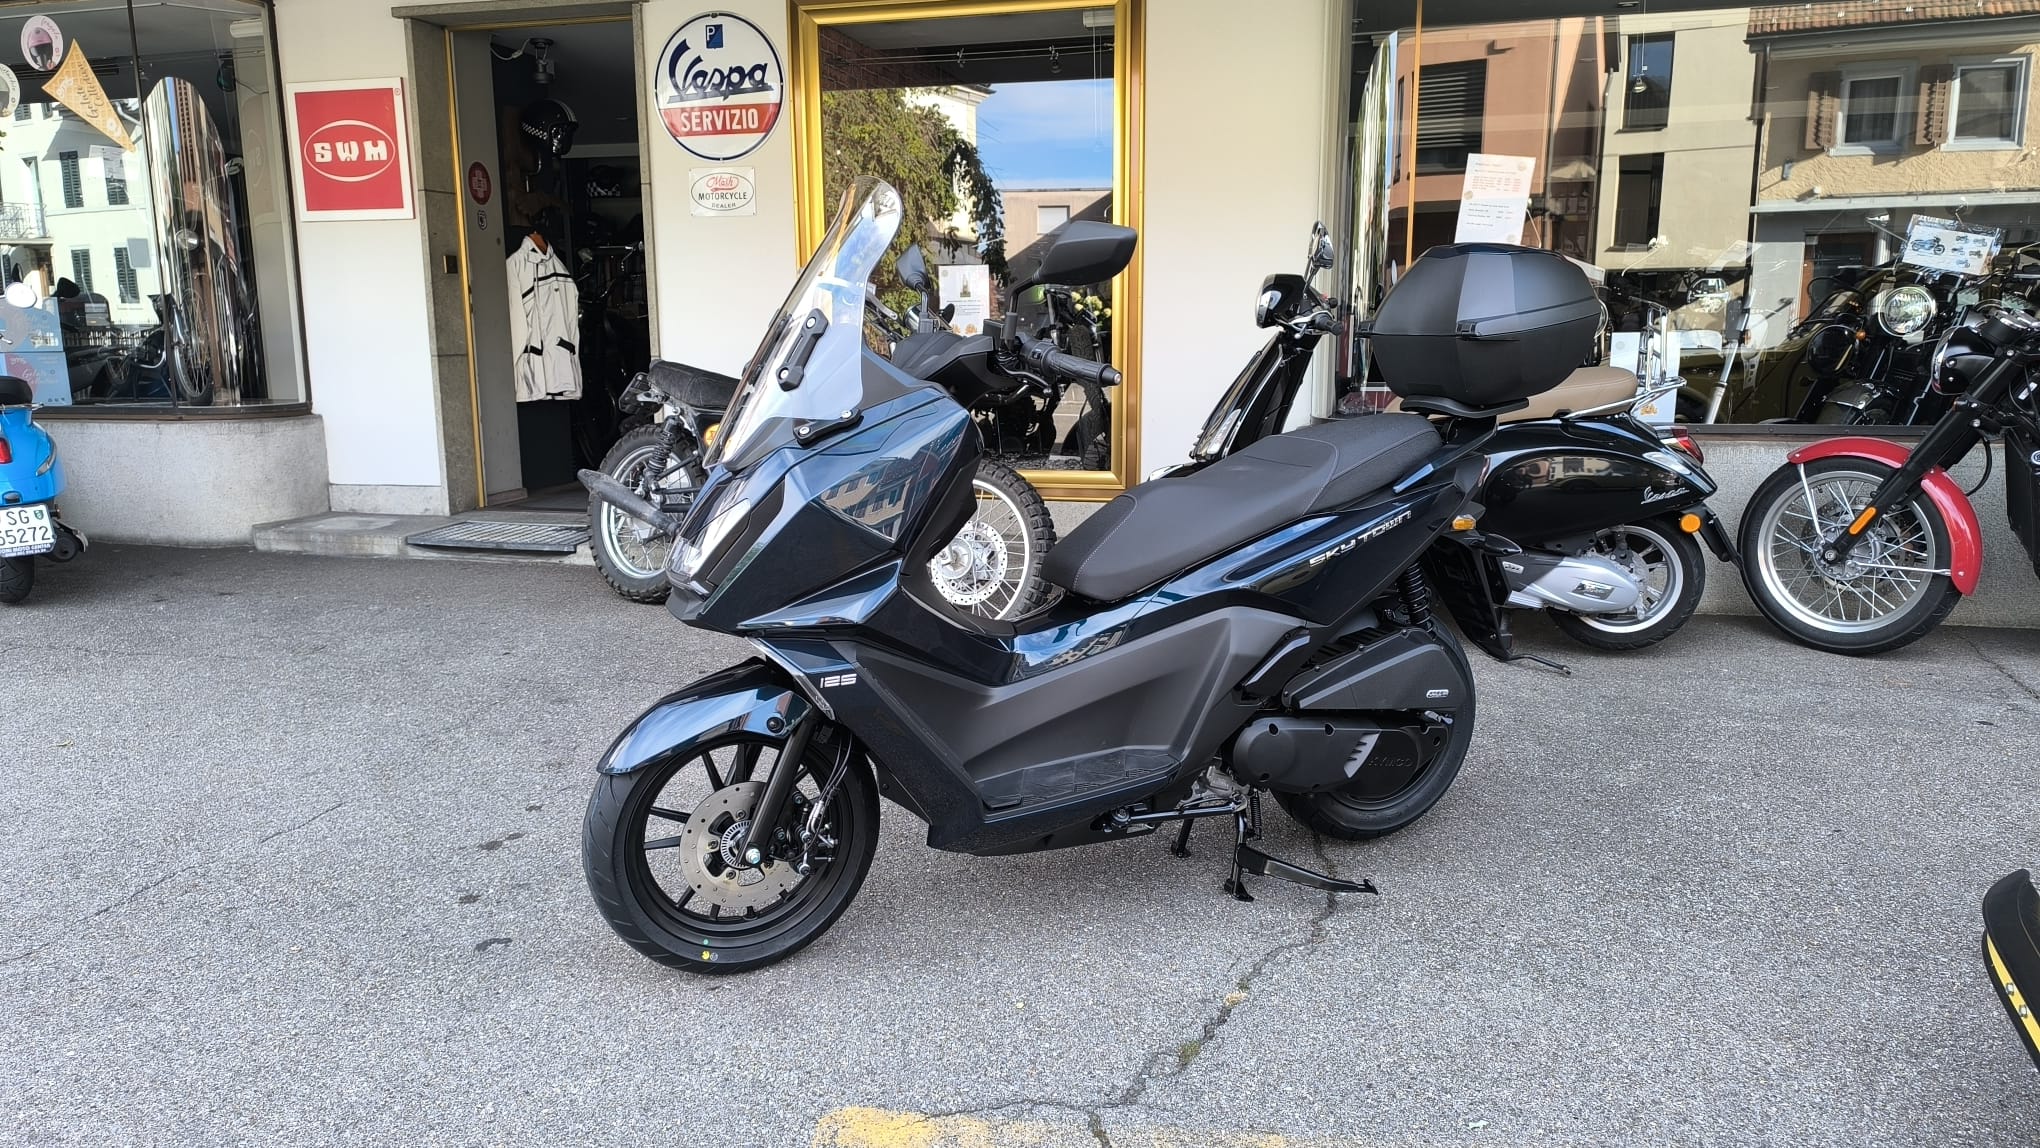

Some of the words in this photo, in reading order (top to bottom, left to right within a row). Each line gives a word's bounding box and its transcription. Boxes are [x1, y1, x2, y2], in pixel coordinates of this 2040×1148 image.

[668, 38, 774, 102] Vespa
[680, 107, 760, 132] SERVIZIO
[313, 140, 388, 163] SWM
[707, 176, 739, 189] Mash
[698, 192, 748, 201] MOTORCYCLE
[6, 509, 30, 526] SG
[1309, 539, 1356, 567] SKY
[820, 673, 857, 689] 125
